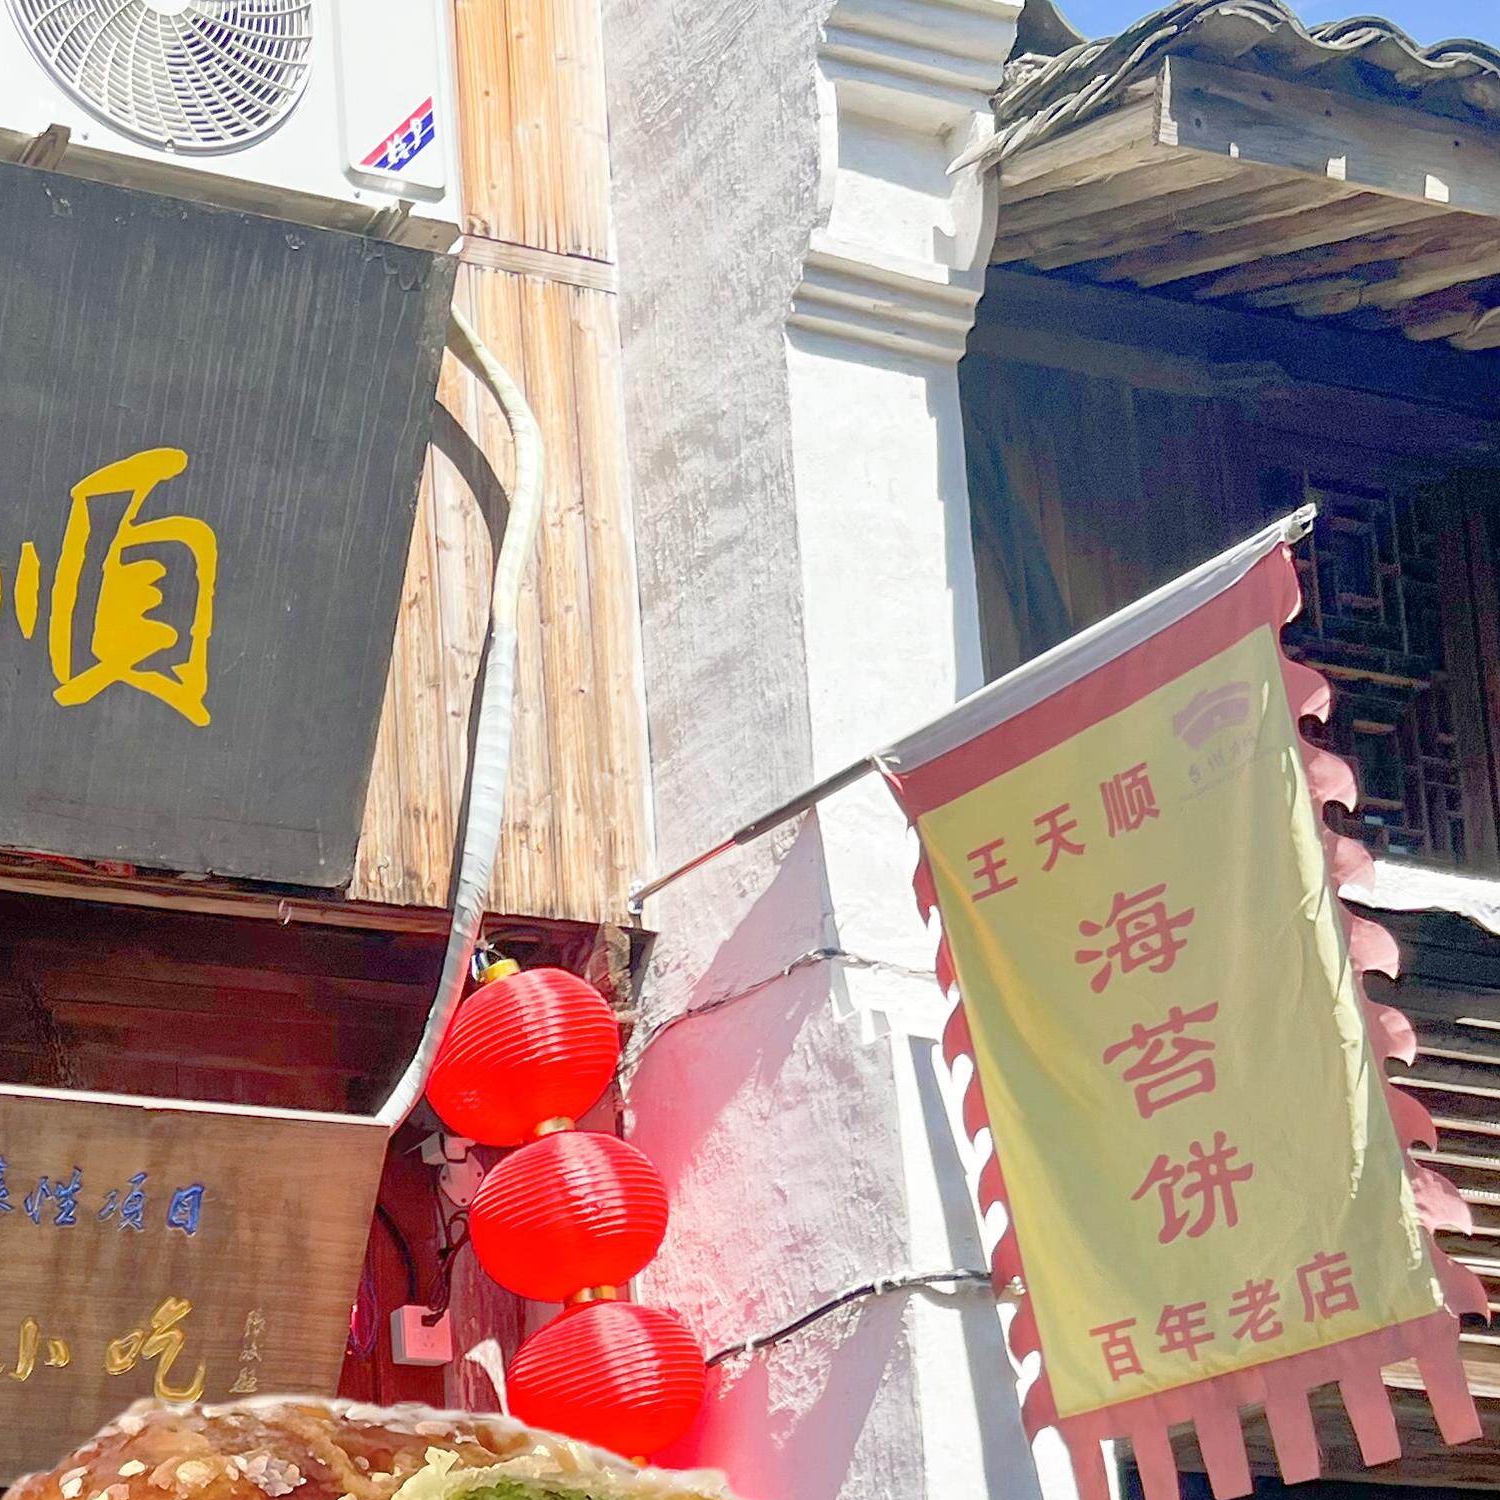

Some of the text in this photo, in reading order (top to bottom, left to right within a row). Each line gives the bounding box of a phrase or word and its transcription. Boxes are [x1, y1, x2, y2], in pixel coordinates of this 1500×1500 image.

[966, 762, 1161, 903] 王天顺
[1074, 882, 1254, 1244] 海苔饼
[1088, 1250, 1361, 1383] 百年老店
